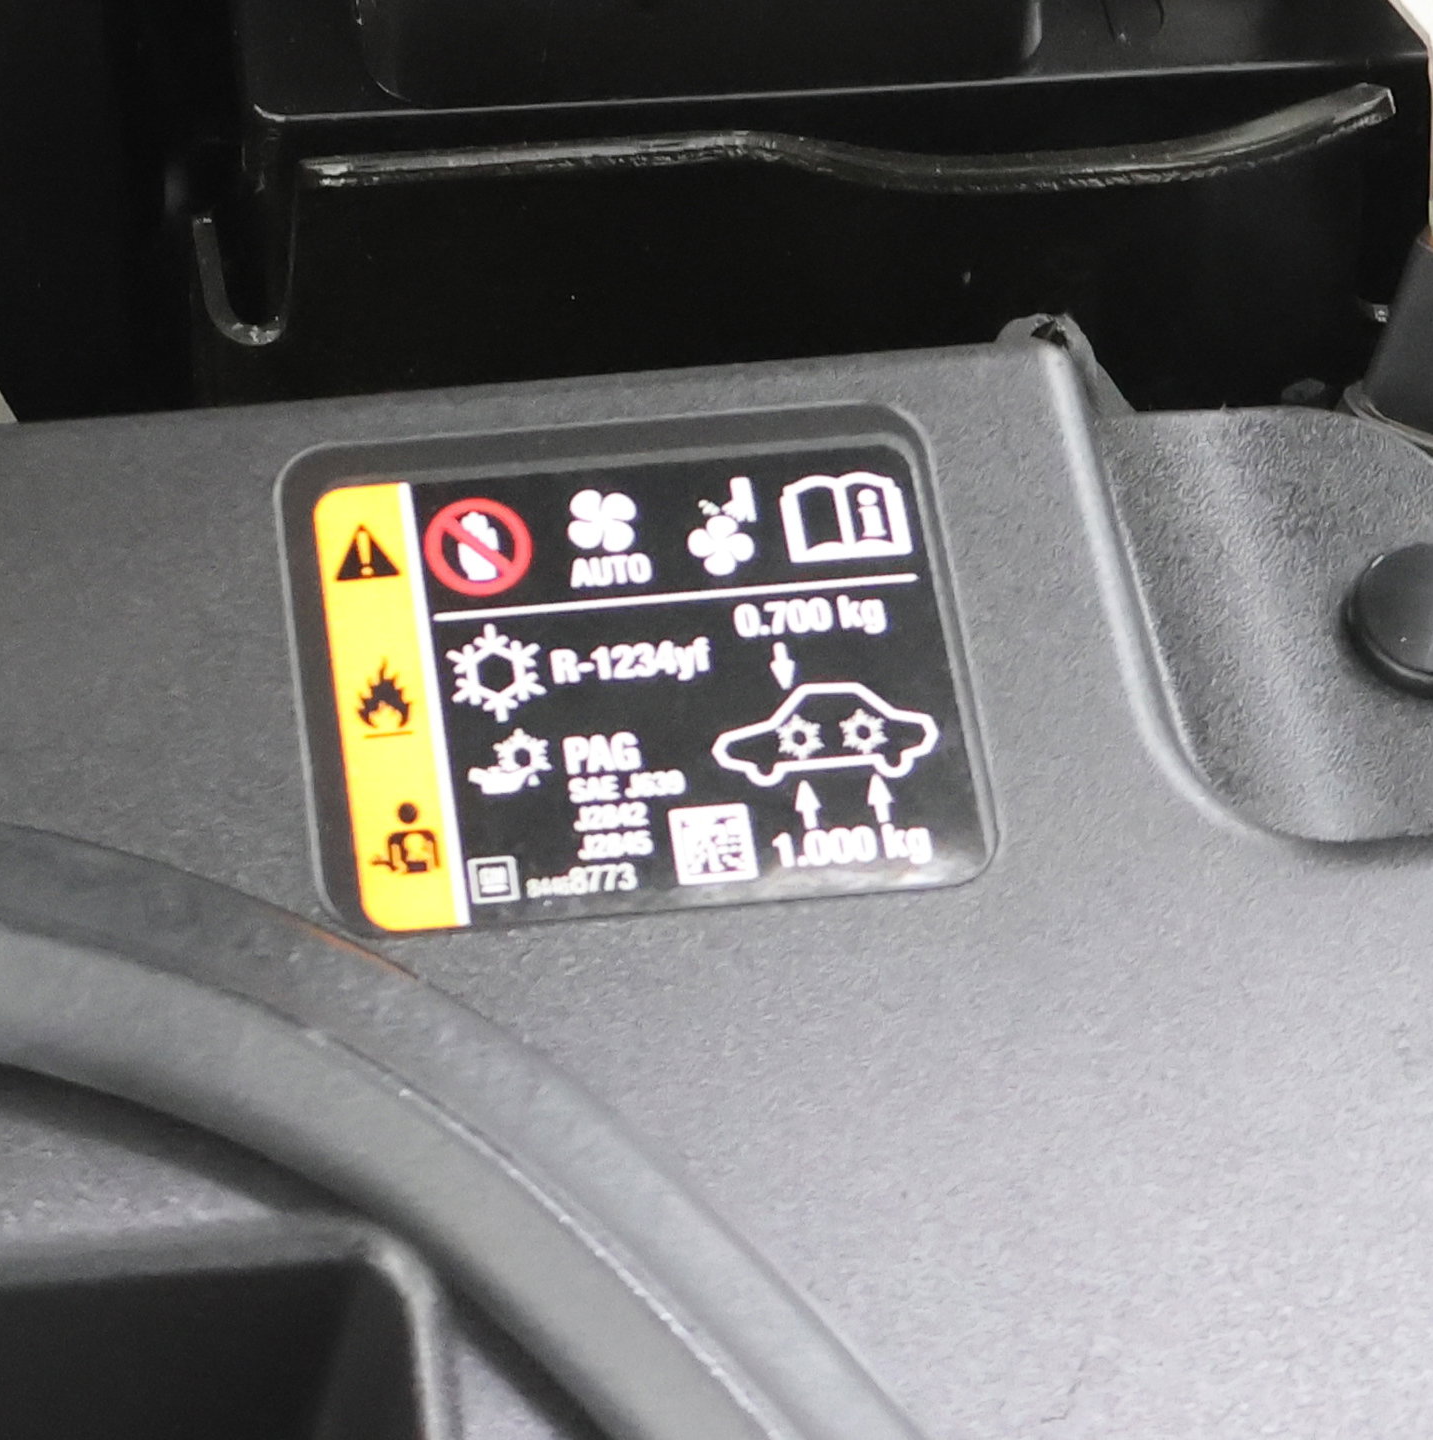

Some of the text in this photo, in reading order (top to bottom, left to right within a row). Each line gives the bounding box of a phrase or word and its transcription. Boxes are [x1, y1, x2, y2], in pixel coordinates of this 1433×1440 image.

[567, 552, 654, 588] AUTO
[732, 591, 887, 638] 0.700 kg
[548, 635, 714, 692] R-1234yf
[561, 730, 643, 776] PAG
[566, 773, 621, 803] SAE
[771, 820, 933, 869] 1.000 kg
